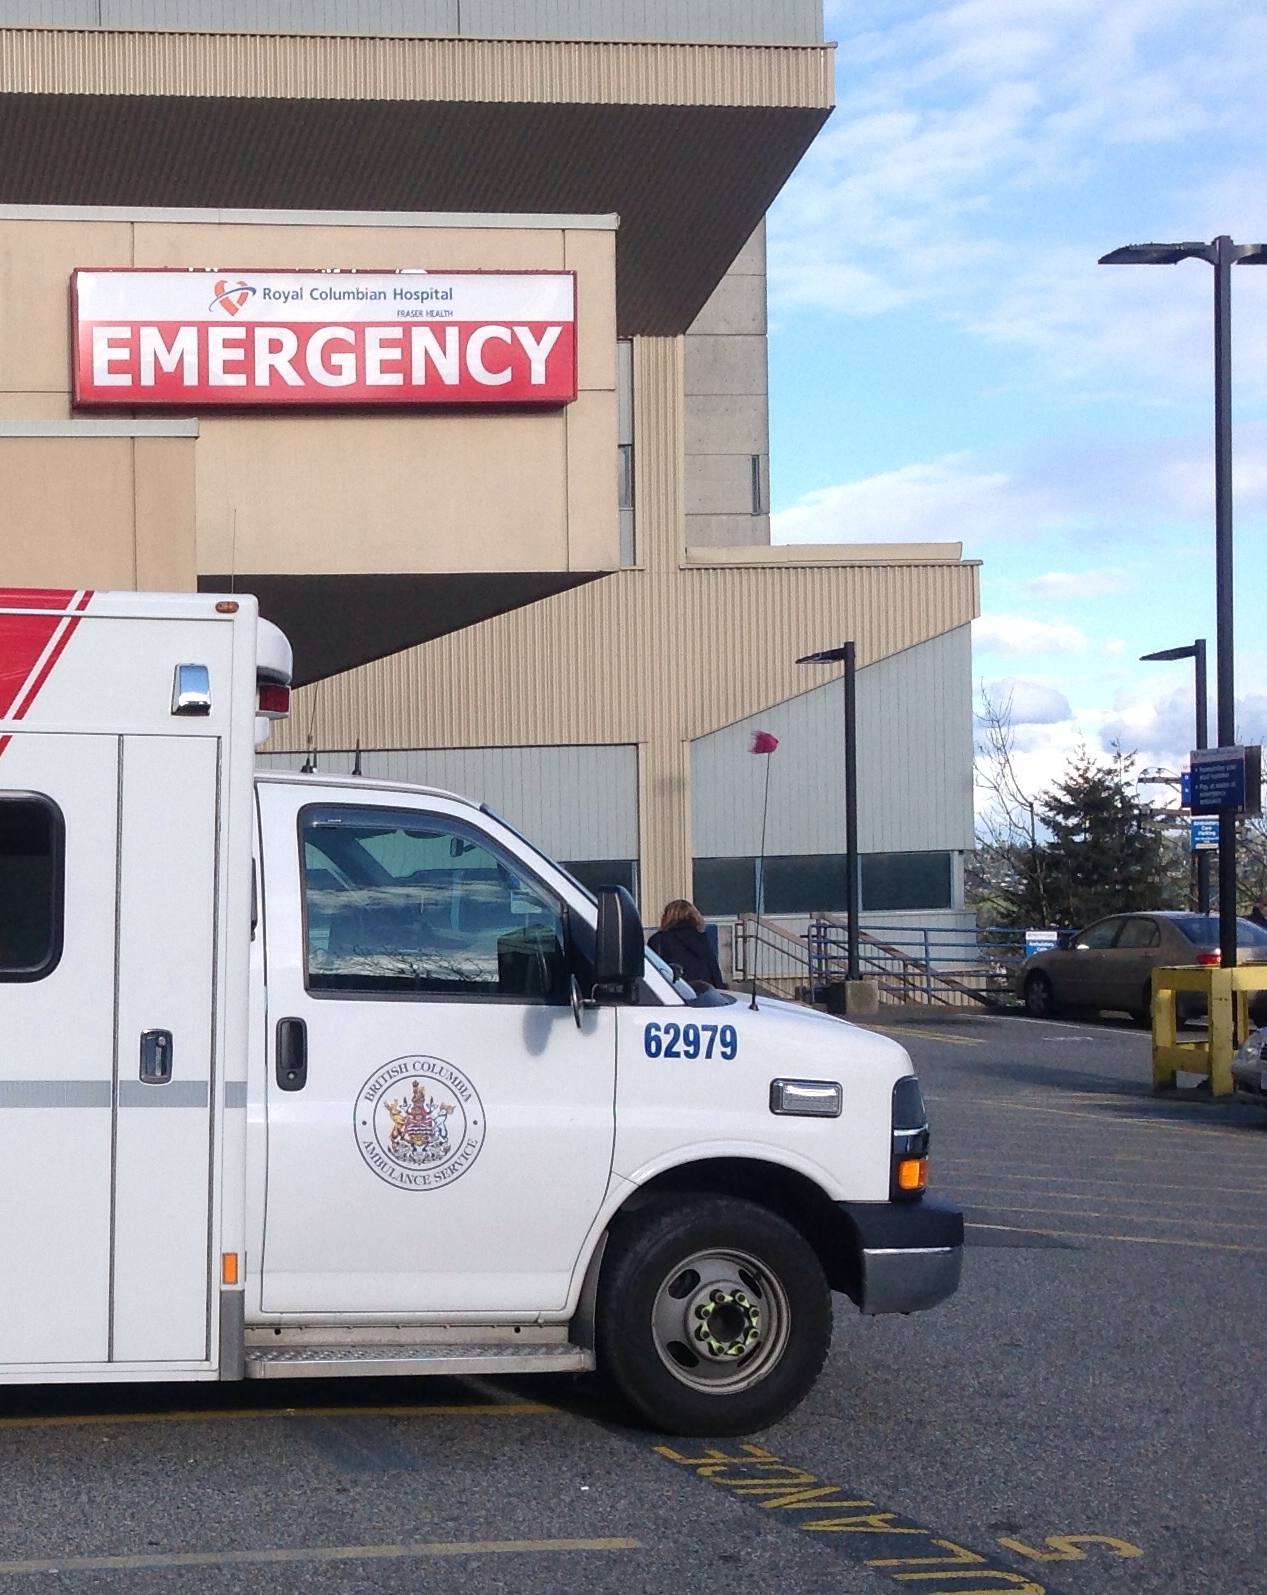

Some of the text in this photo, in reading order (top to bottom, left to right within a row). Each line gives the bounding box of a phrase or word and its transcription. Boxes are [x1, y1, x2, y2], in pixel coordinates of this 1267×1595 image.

[262, 286, 453, 304] Royal Columbian Hospital
[397, 310, 453, 318] FRASER HEALTH
[92, 325, 562, 388] EMERGENCY
[644, 1022, 737, 1060] 62979
[364, 1060, 472, 1103] BRITISH COLUMBIA
[363, 1138, 478, 1186] AMBULANCE SERVICE
